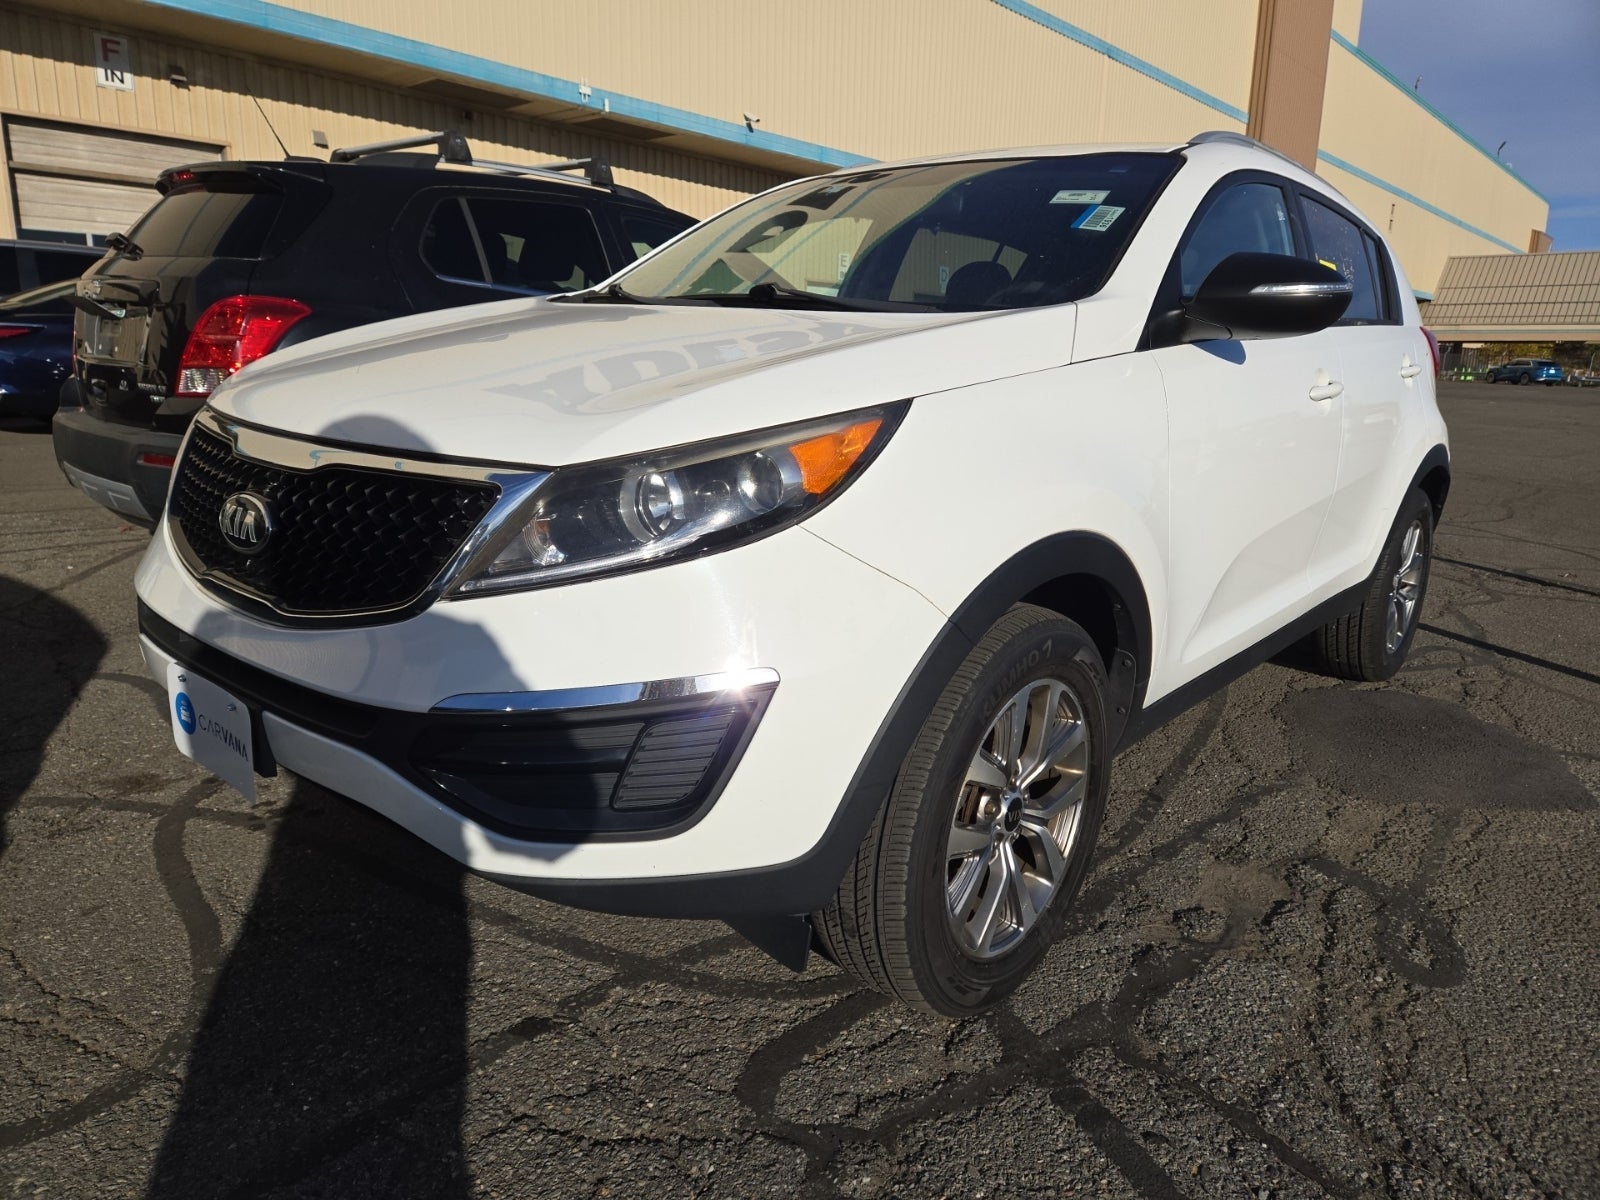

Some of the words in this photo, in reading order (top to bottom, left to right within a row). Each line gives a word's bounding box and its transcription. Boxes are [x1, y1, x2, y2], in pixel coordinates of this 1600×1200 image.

[101, 37, 121, 62] F
[104, 66, 125, 84] IN
[840, 254, 849, 268] E
[223, 503, 257, 542] KIA
[198, 714, 248, 761] CARVANA
